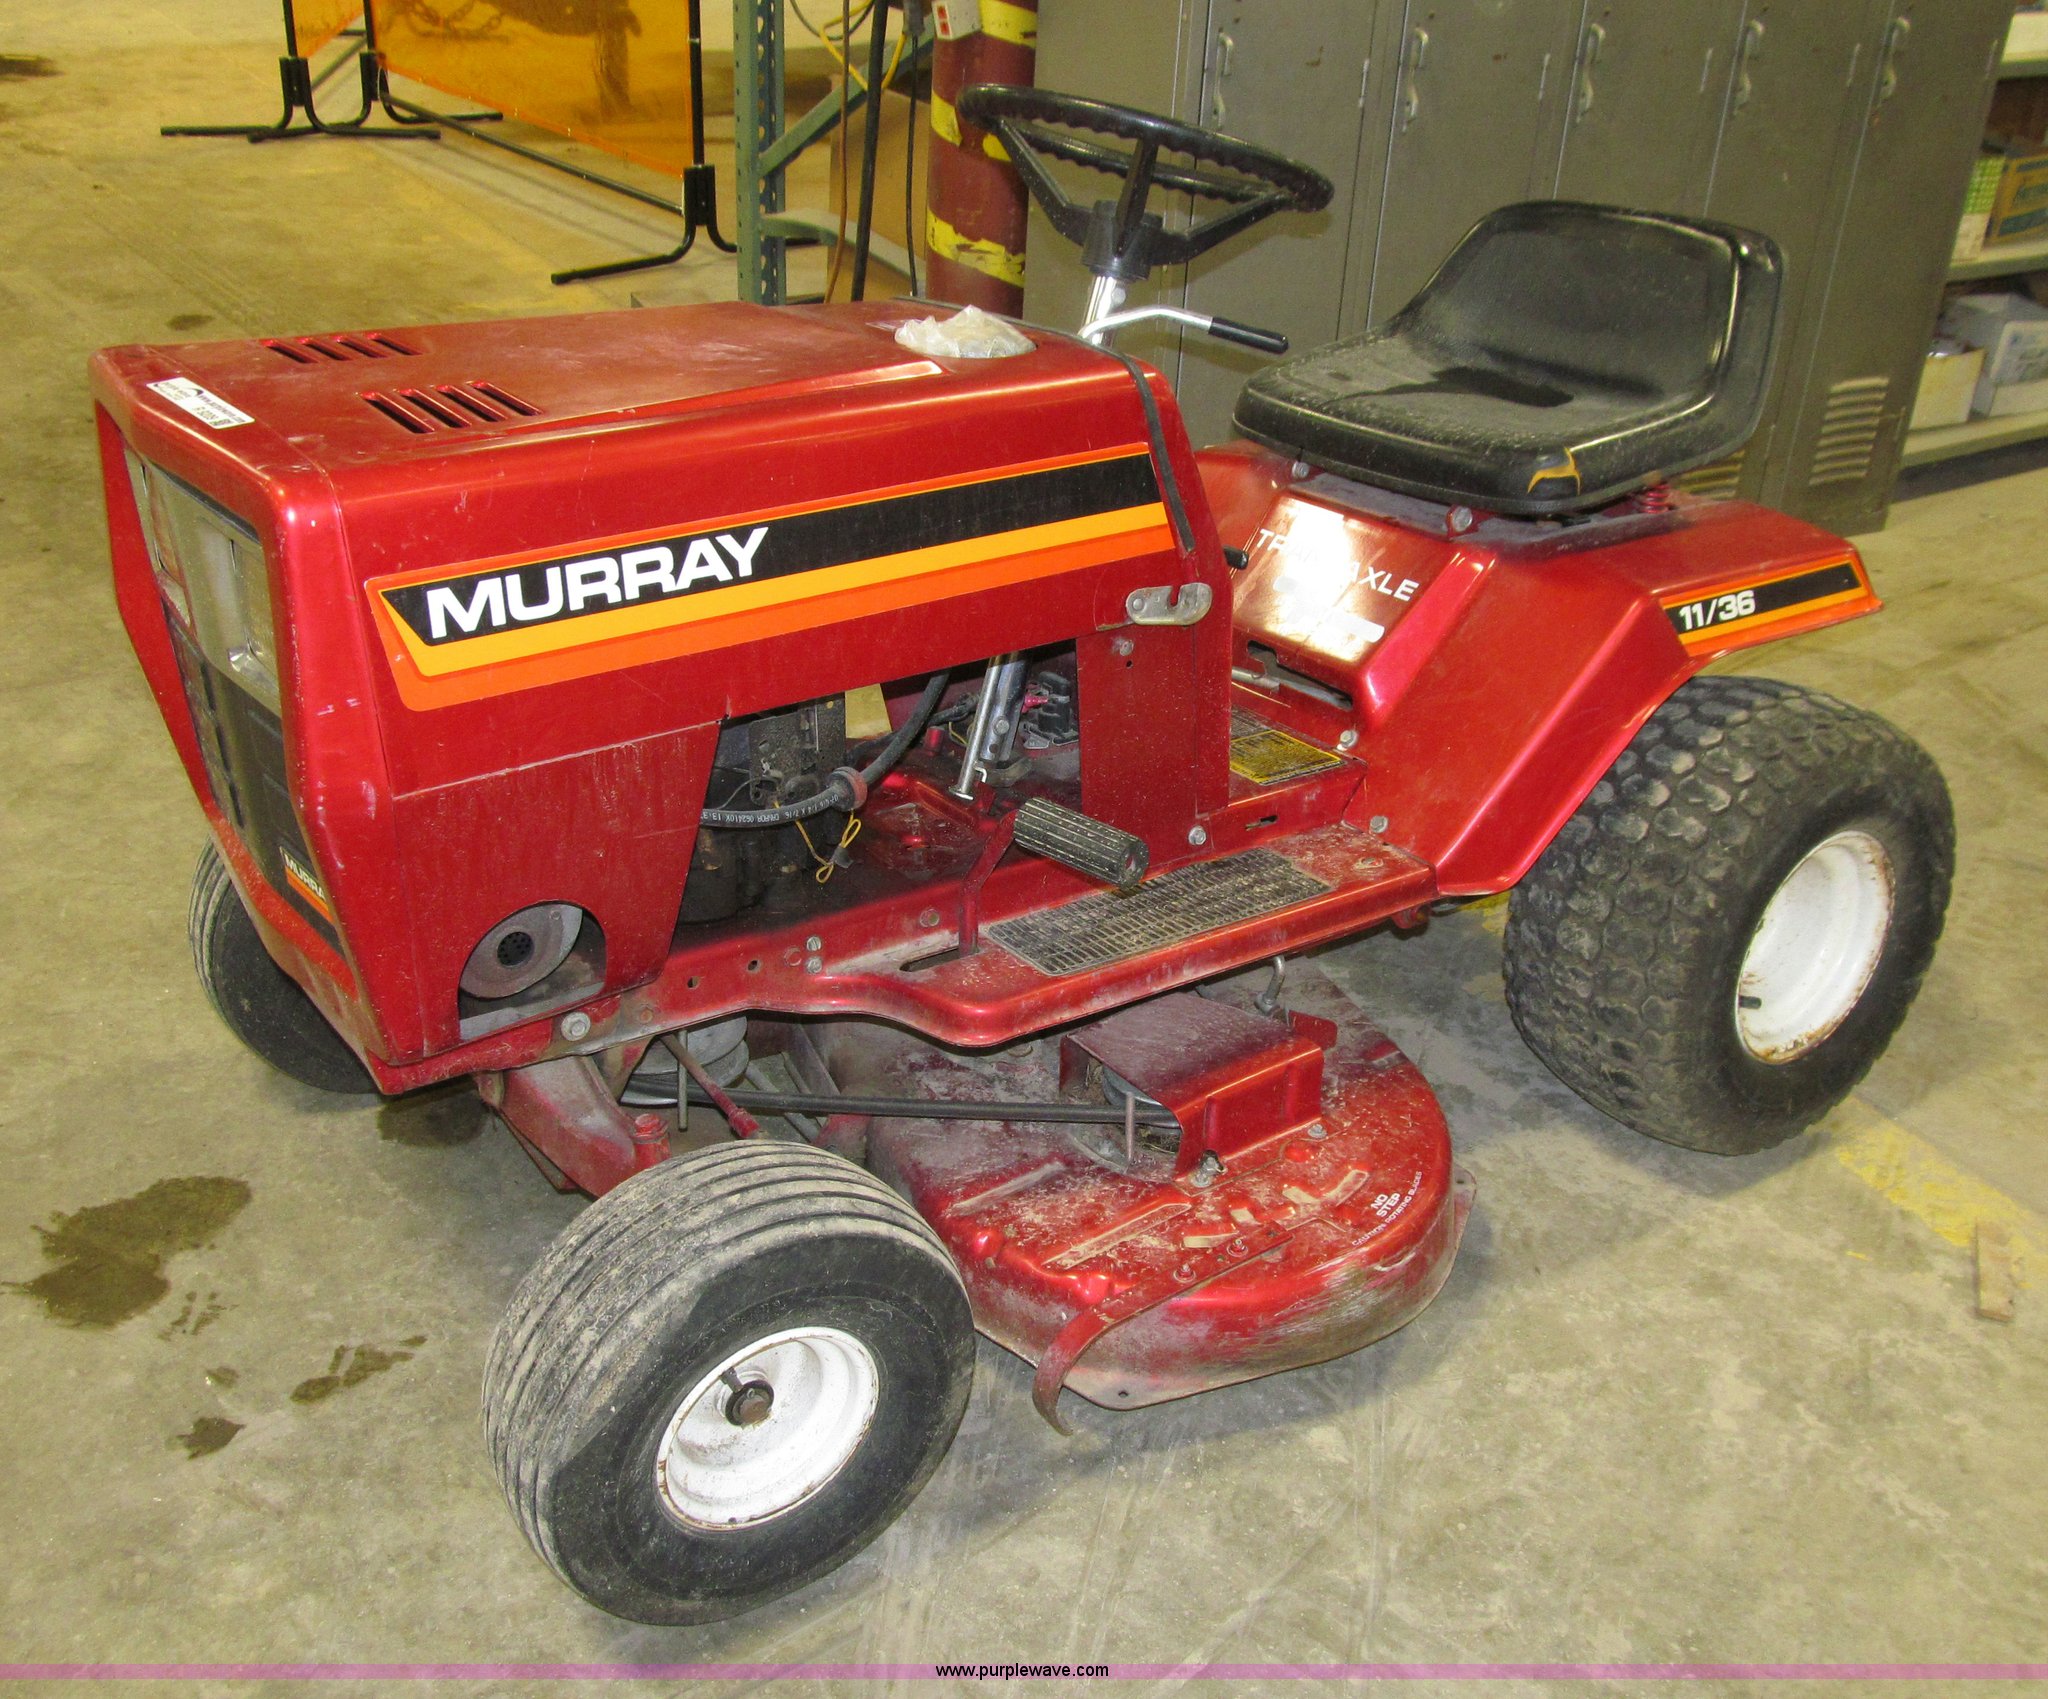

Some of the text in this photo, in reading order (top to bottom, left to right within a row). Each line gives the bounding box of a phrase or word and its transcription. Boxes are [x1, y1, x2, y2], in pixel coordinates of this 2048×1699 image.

[426, 526, 769, 639] MURRAY
[1678, 589, 1756, 631] 11/36
[1351, 1171, 1423, 1246] CAUTION ROTATING BLADES
[1370, 1193, 1388, 1209] NO
[1376, 1192, 1401, 1217] STEP
